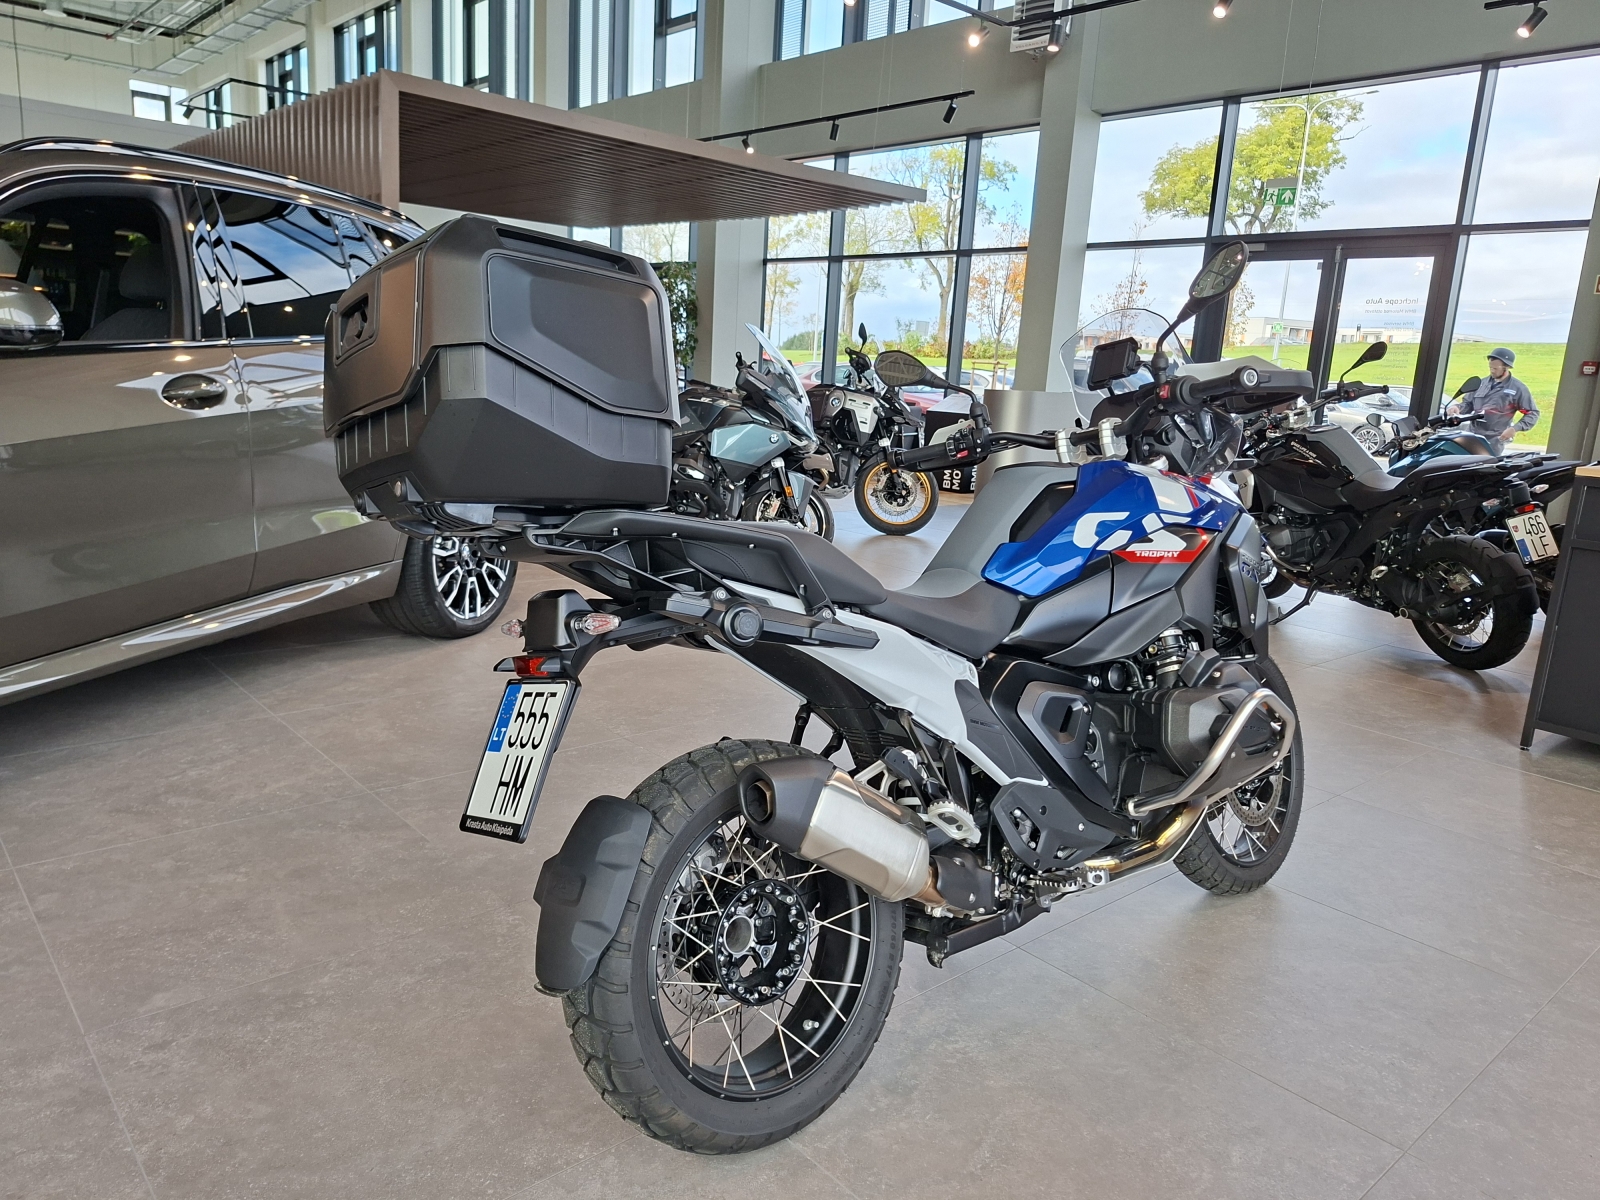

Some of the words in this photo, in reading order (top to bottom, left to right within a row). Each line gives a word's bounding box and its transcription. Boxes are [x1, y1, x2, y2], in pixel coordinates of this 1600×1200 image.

[952, 469, 961, 490] MO
[1523, 515, 1546, 537] 466
[1134, 550, 1180, 558] TROPHY
[1531, 535, 1549, 557] LF
[508, 692, 557, 750] 555
[493, 728, 506, 740] LT
[490, 754, 534, 817] HM
[465, 818, 481, 829] Krasta
[481, 821, 493, 832] Auto
